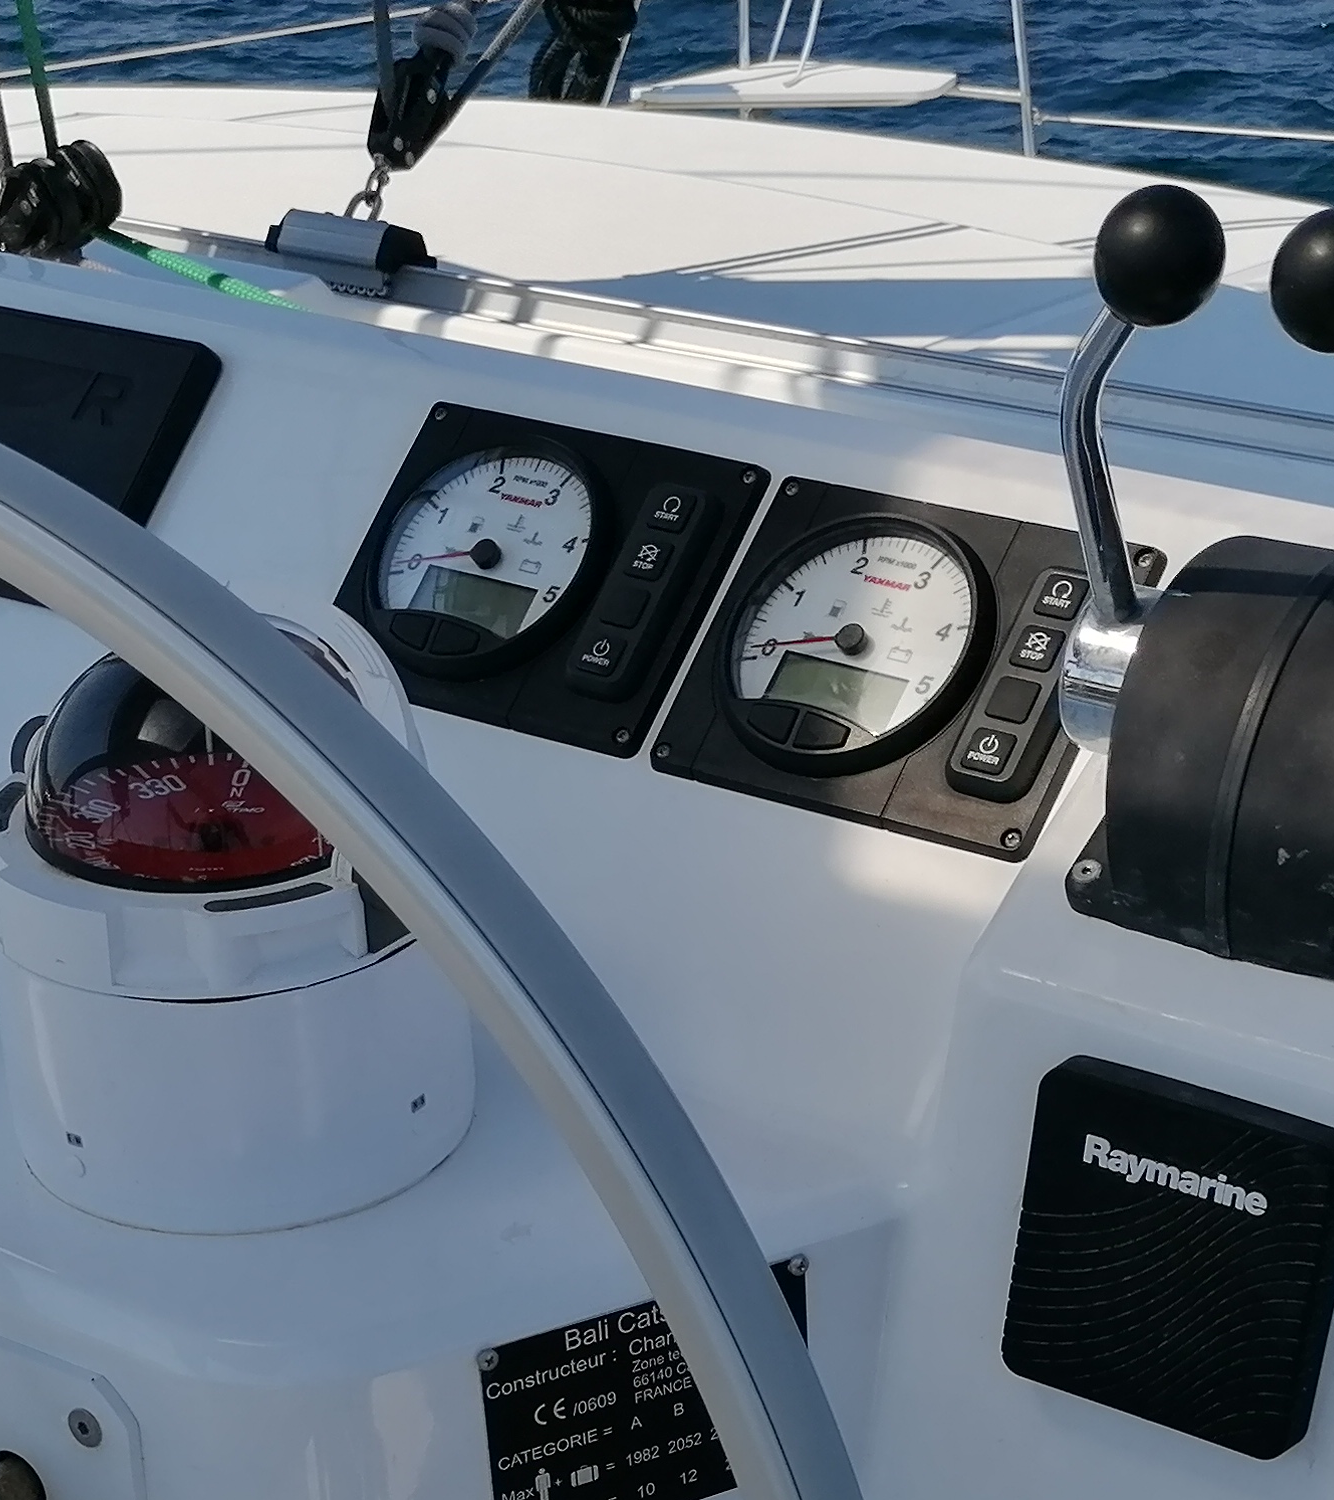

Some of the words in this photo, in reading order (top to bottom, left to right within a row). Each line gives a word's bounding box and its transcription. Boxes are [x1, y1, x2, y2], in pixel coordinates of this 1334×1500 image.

[488, 476, 506, 494] 2
[500, 492, 543, 508] YANMAR
[544, 488, 561, 506] 3
[436, 507, 450, 525] 1
[653, 509, 680, 522] START
[561, 536, 579, 553] 4
[631, 560, 655, 571] STOP
[850, 556, 869, 575] 2
[863, 574, 912, 592] YANMAR
[914, 571, 932, 589] 3
[542, 585, 561, 603] 5
[793, 589, 807, 607] 1
[1041, 595, 1072, 609] START
[935, 622, 954, 642] 4
[581, 653, 611, 668] POWER
[1019, 649, 1045, 661] STOP
[915, 675, 935, 695] 5
[966, 750, 1000, 766] POWER
[128, 773, 187, 800] 330
[231, 768, 252, 787] 0
[229, 787, 245, 798] N
[1082, 1133, 1268, 1216] Raymarine
[564, 1318, 610, 1352] Bali
[632, 1354, 665, 1373] Zone
[485, 1350, 607, 1400] Constructeur
[633, 1366, 673, 1388] 66140
[676, 1361, 690, 1375] C
[634, 1376, 693, 1404] FRANCE
[572, 1390, 617, 1417] /0609
[497, 1427, 599, 1471] CATEGORIE
[630, 1416, 643, 1430] A
[673, 1402, 685, 1417] B
[625, 1445, 660, 1467] 1982
[667, 1432, 702, 1455] 2052
[636, 1481, 656, 1499] 10
[679, 1468, 698, 1485] 12
